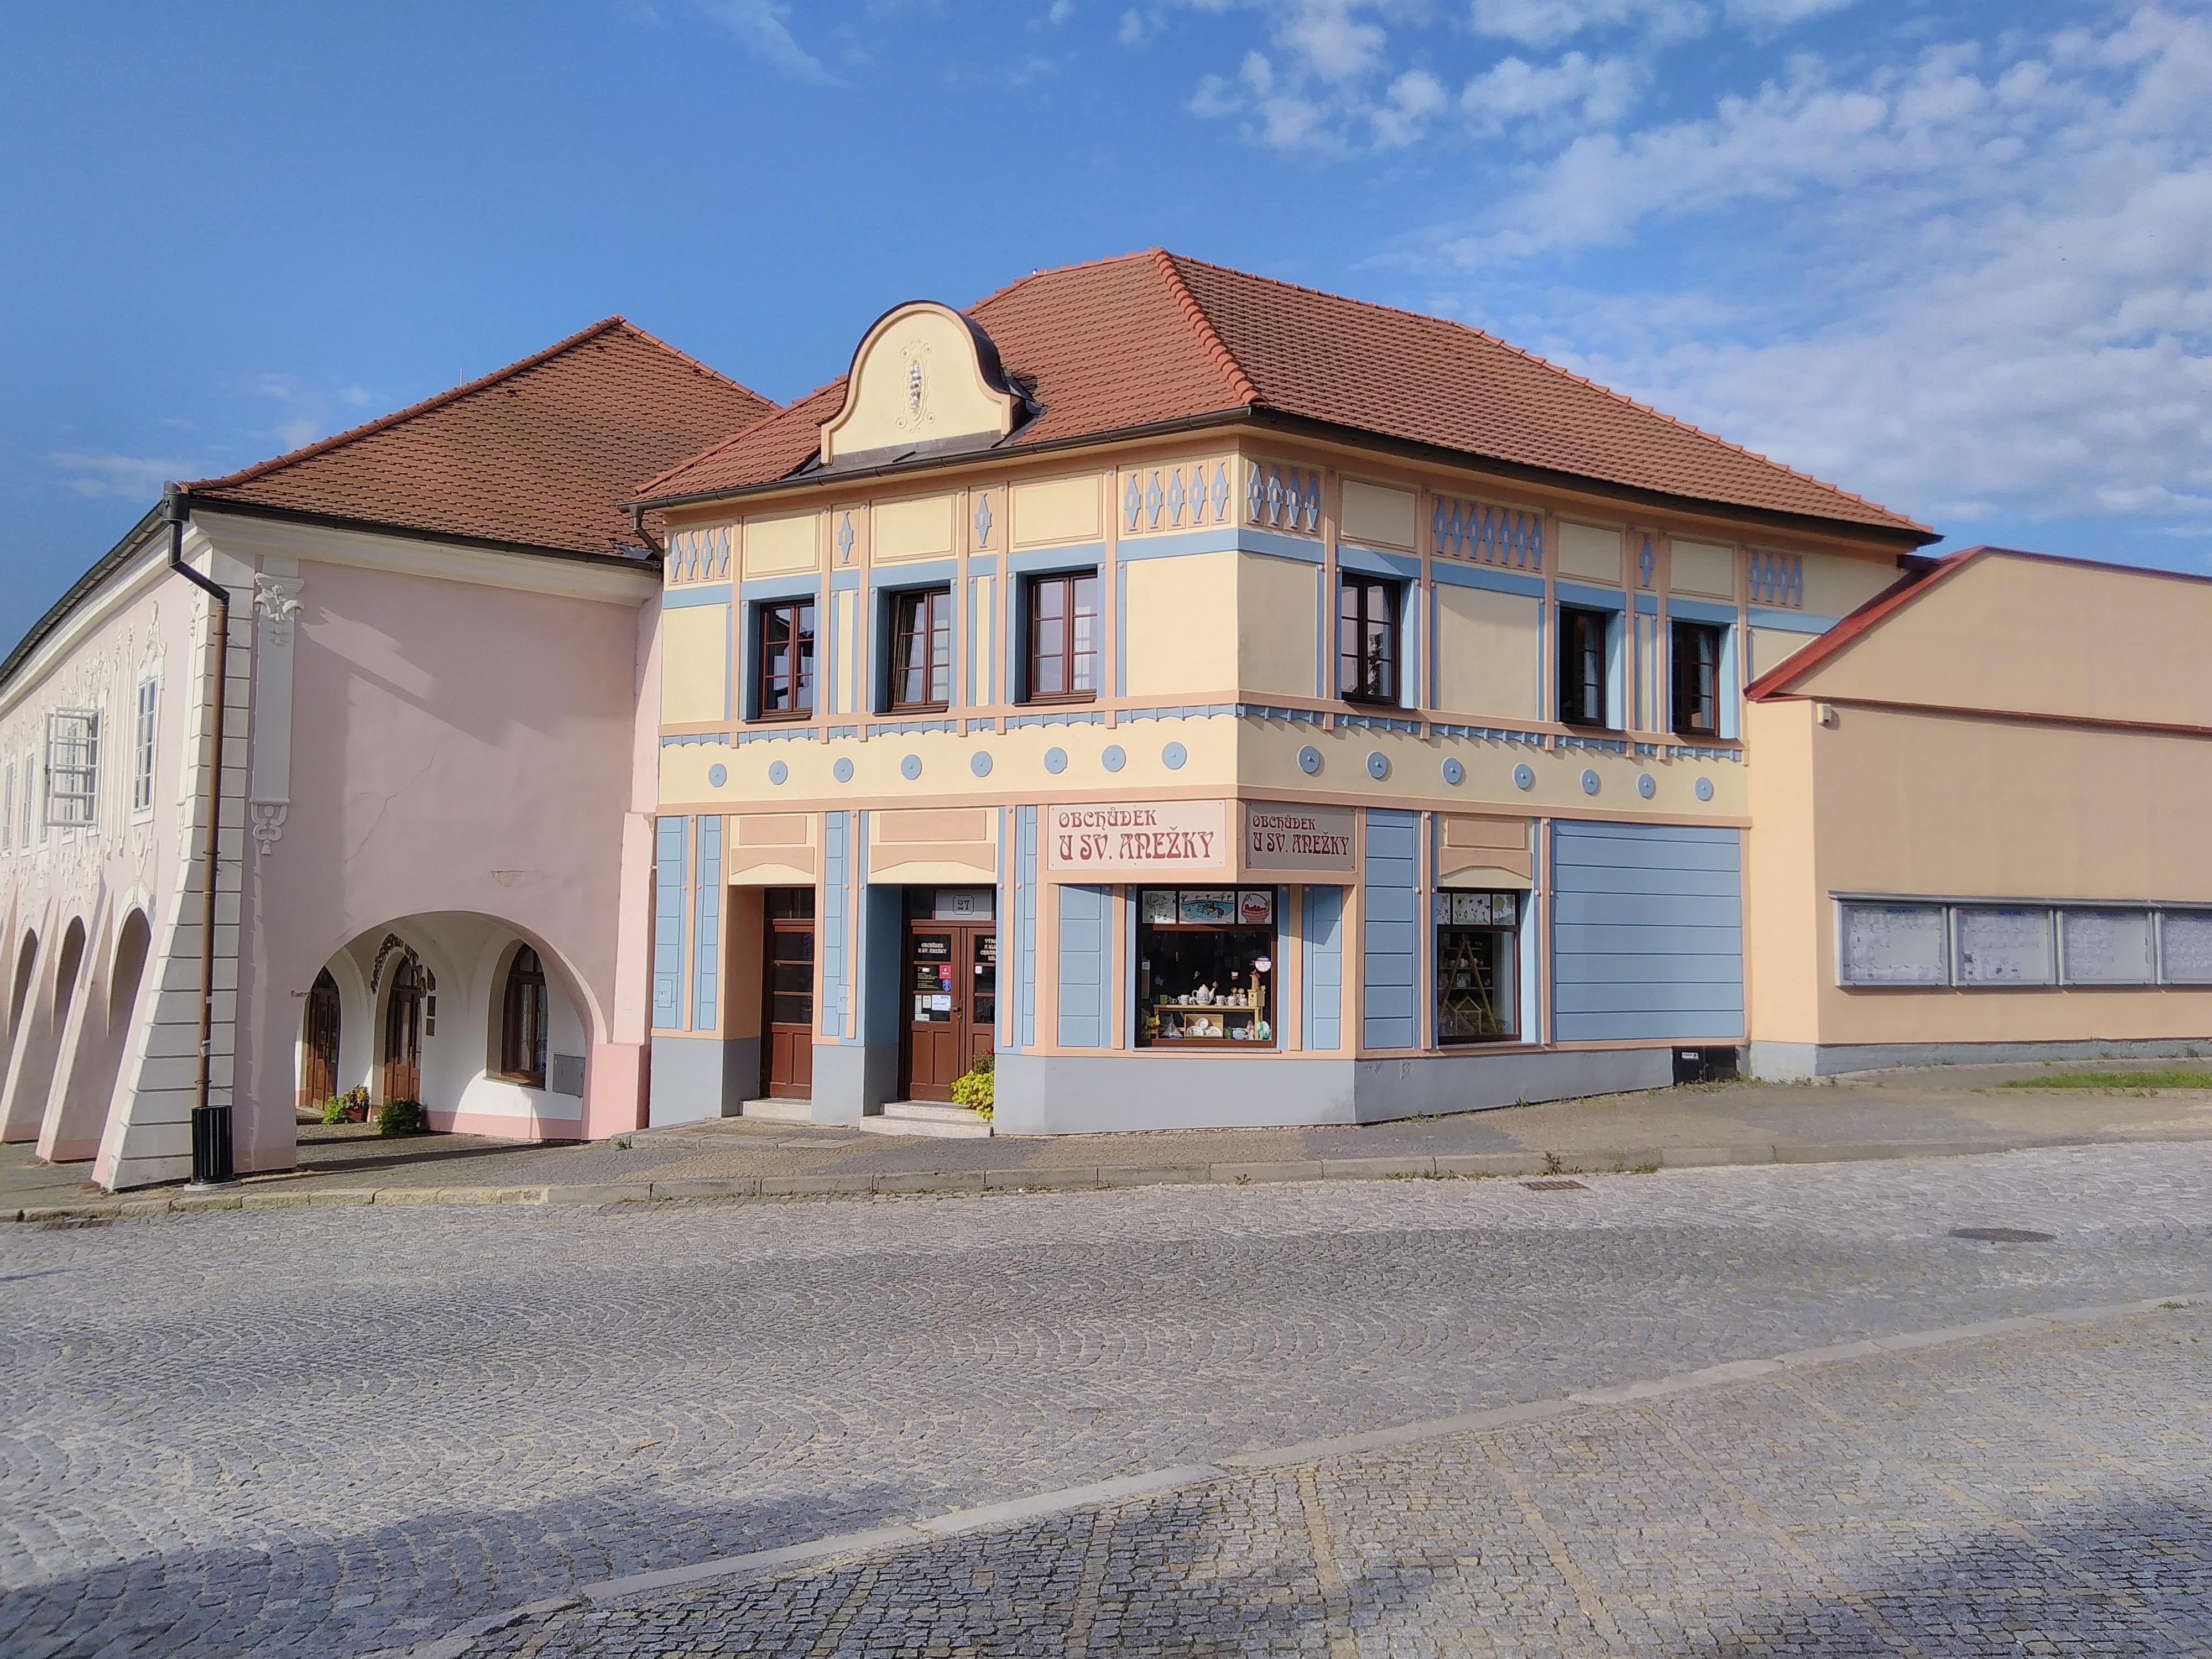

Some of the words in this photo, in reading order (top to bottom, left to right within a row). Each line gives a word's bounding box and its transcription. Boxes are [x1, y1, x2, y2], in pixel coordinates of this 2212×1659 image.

[1059, 807, 1157, 831] OBCHŮDEK
[1253, 814, 1316, 831] OBCHŮDEK
[1059, 834, 1073, 860] U
[1080, 833, 1113, 860] SV.
[1119, 826, 1214, 859] ANEŽKY
[1253, 832, 1262, 852] U
[1267, 833, 1288, 853] SV.
[1292, 831, 1349, 855] ANEŽKY
[957, 900, 970, 910] 27
